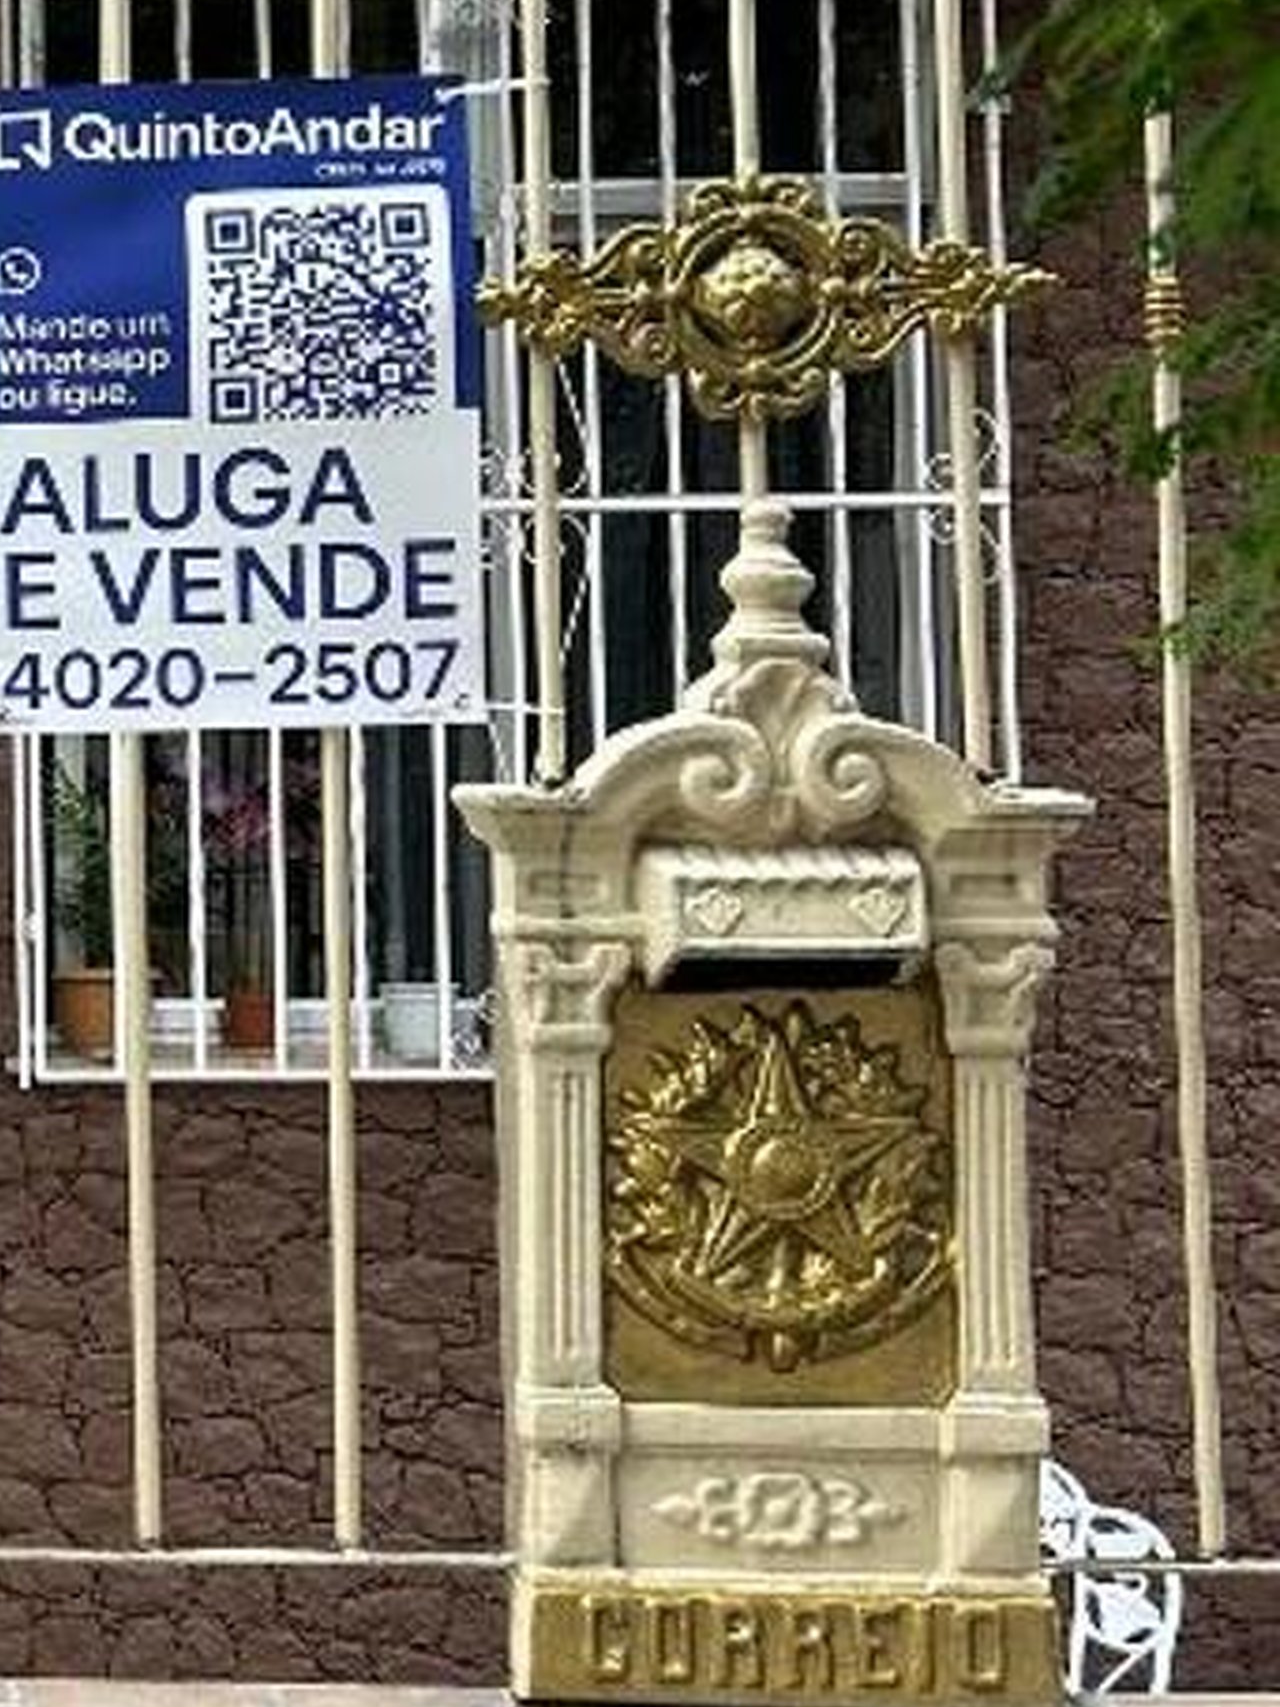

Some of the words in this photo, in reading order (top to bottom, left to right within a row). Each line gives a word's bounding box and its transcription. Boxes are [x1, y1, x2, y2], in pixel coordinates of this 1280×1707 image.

[62, 103, 446, 162] QuintoAndar
[0, 447, 374, 535] ALUGA
[3, 552, 62, 632] E
[90, 538, 460, 626] VENDE
[2, 638, 461, 710] 4020-2507
[583, 1596, 1010, 1694] CORREIO
